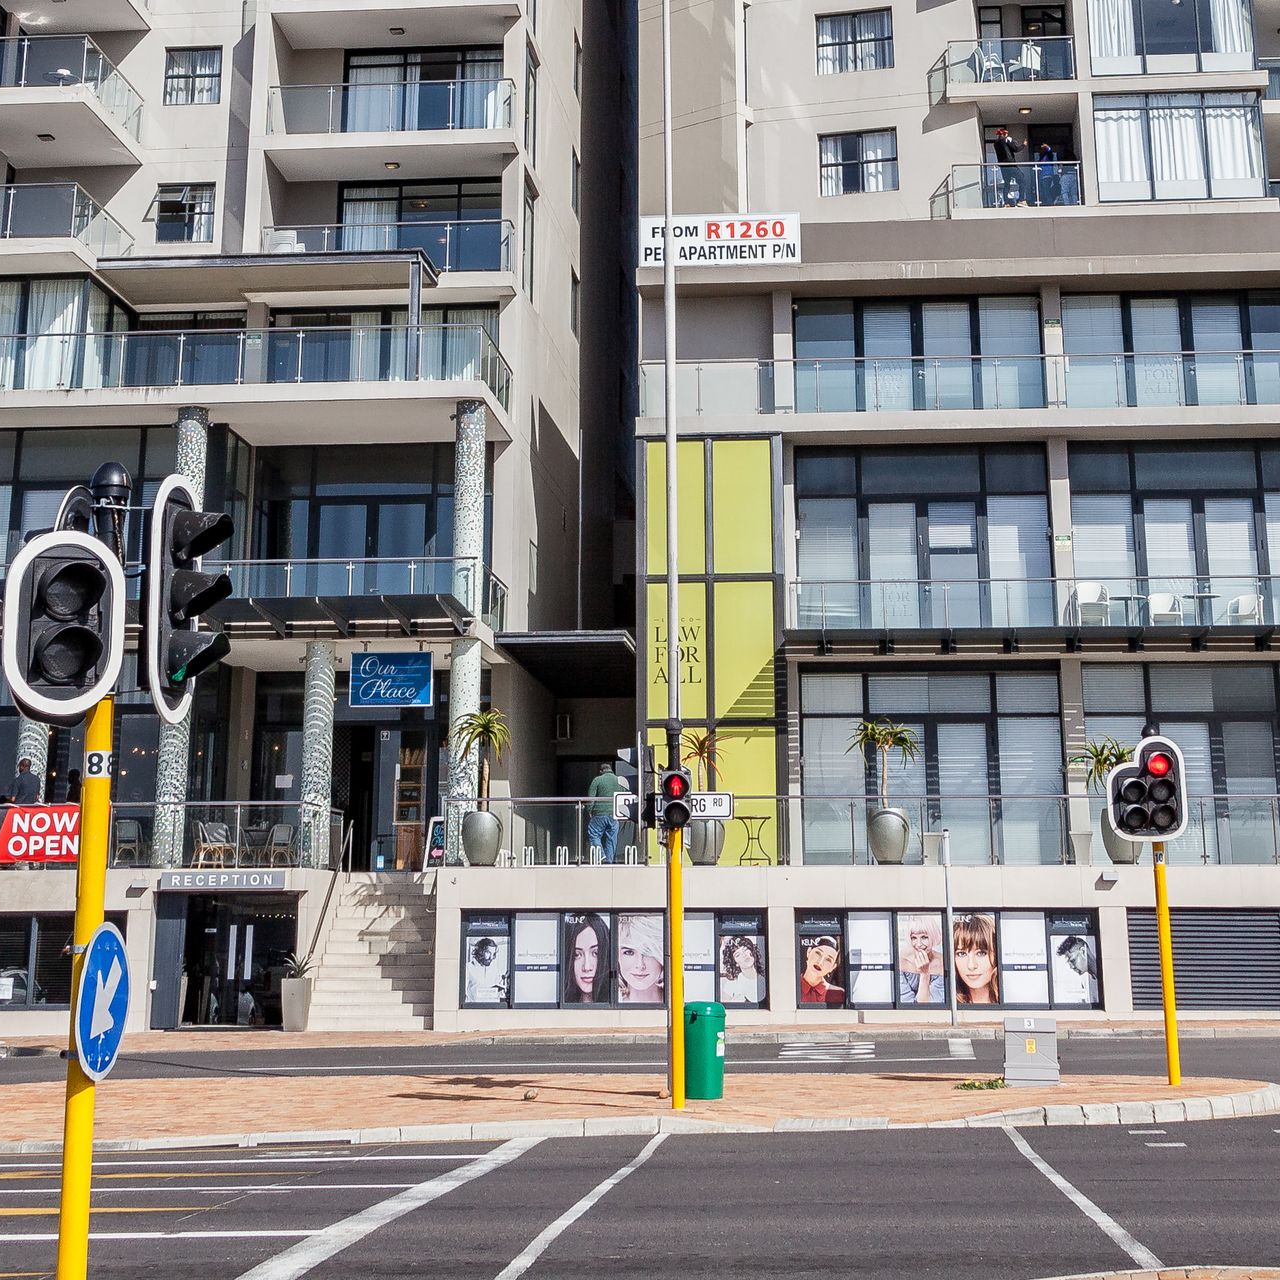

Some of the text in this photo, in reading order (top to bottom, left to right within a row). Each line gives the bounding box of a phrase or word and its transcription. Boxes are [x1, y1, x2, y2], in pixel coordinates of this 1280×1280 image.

[706, 220, 785, 239] R1260
[679, 244, 767, 260] APARTMENT
[752, 242, 776, 258] P/N
[360, 655, 398, 678] Our
[358, 678, 417, 700] Place
[712, 798, 723, 807] RD
[12, 812, 79, 833] NOW
[7, 835, 79, 855] OPEN
[171, 874, 273, 886] RECEPTION
